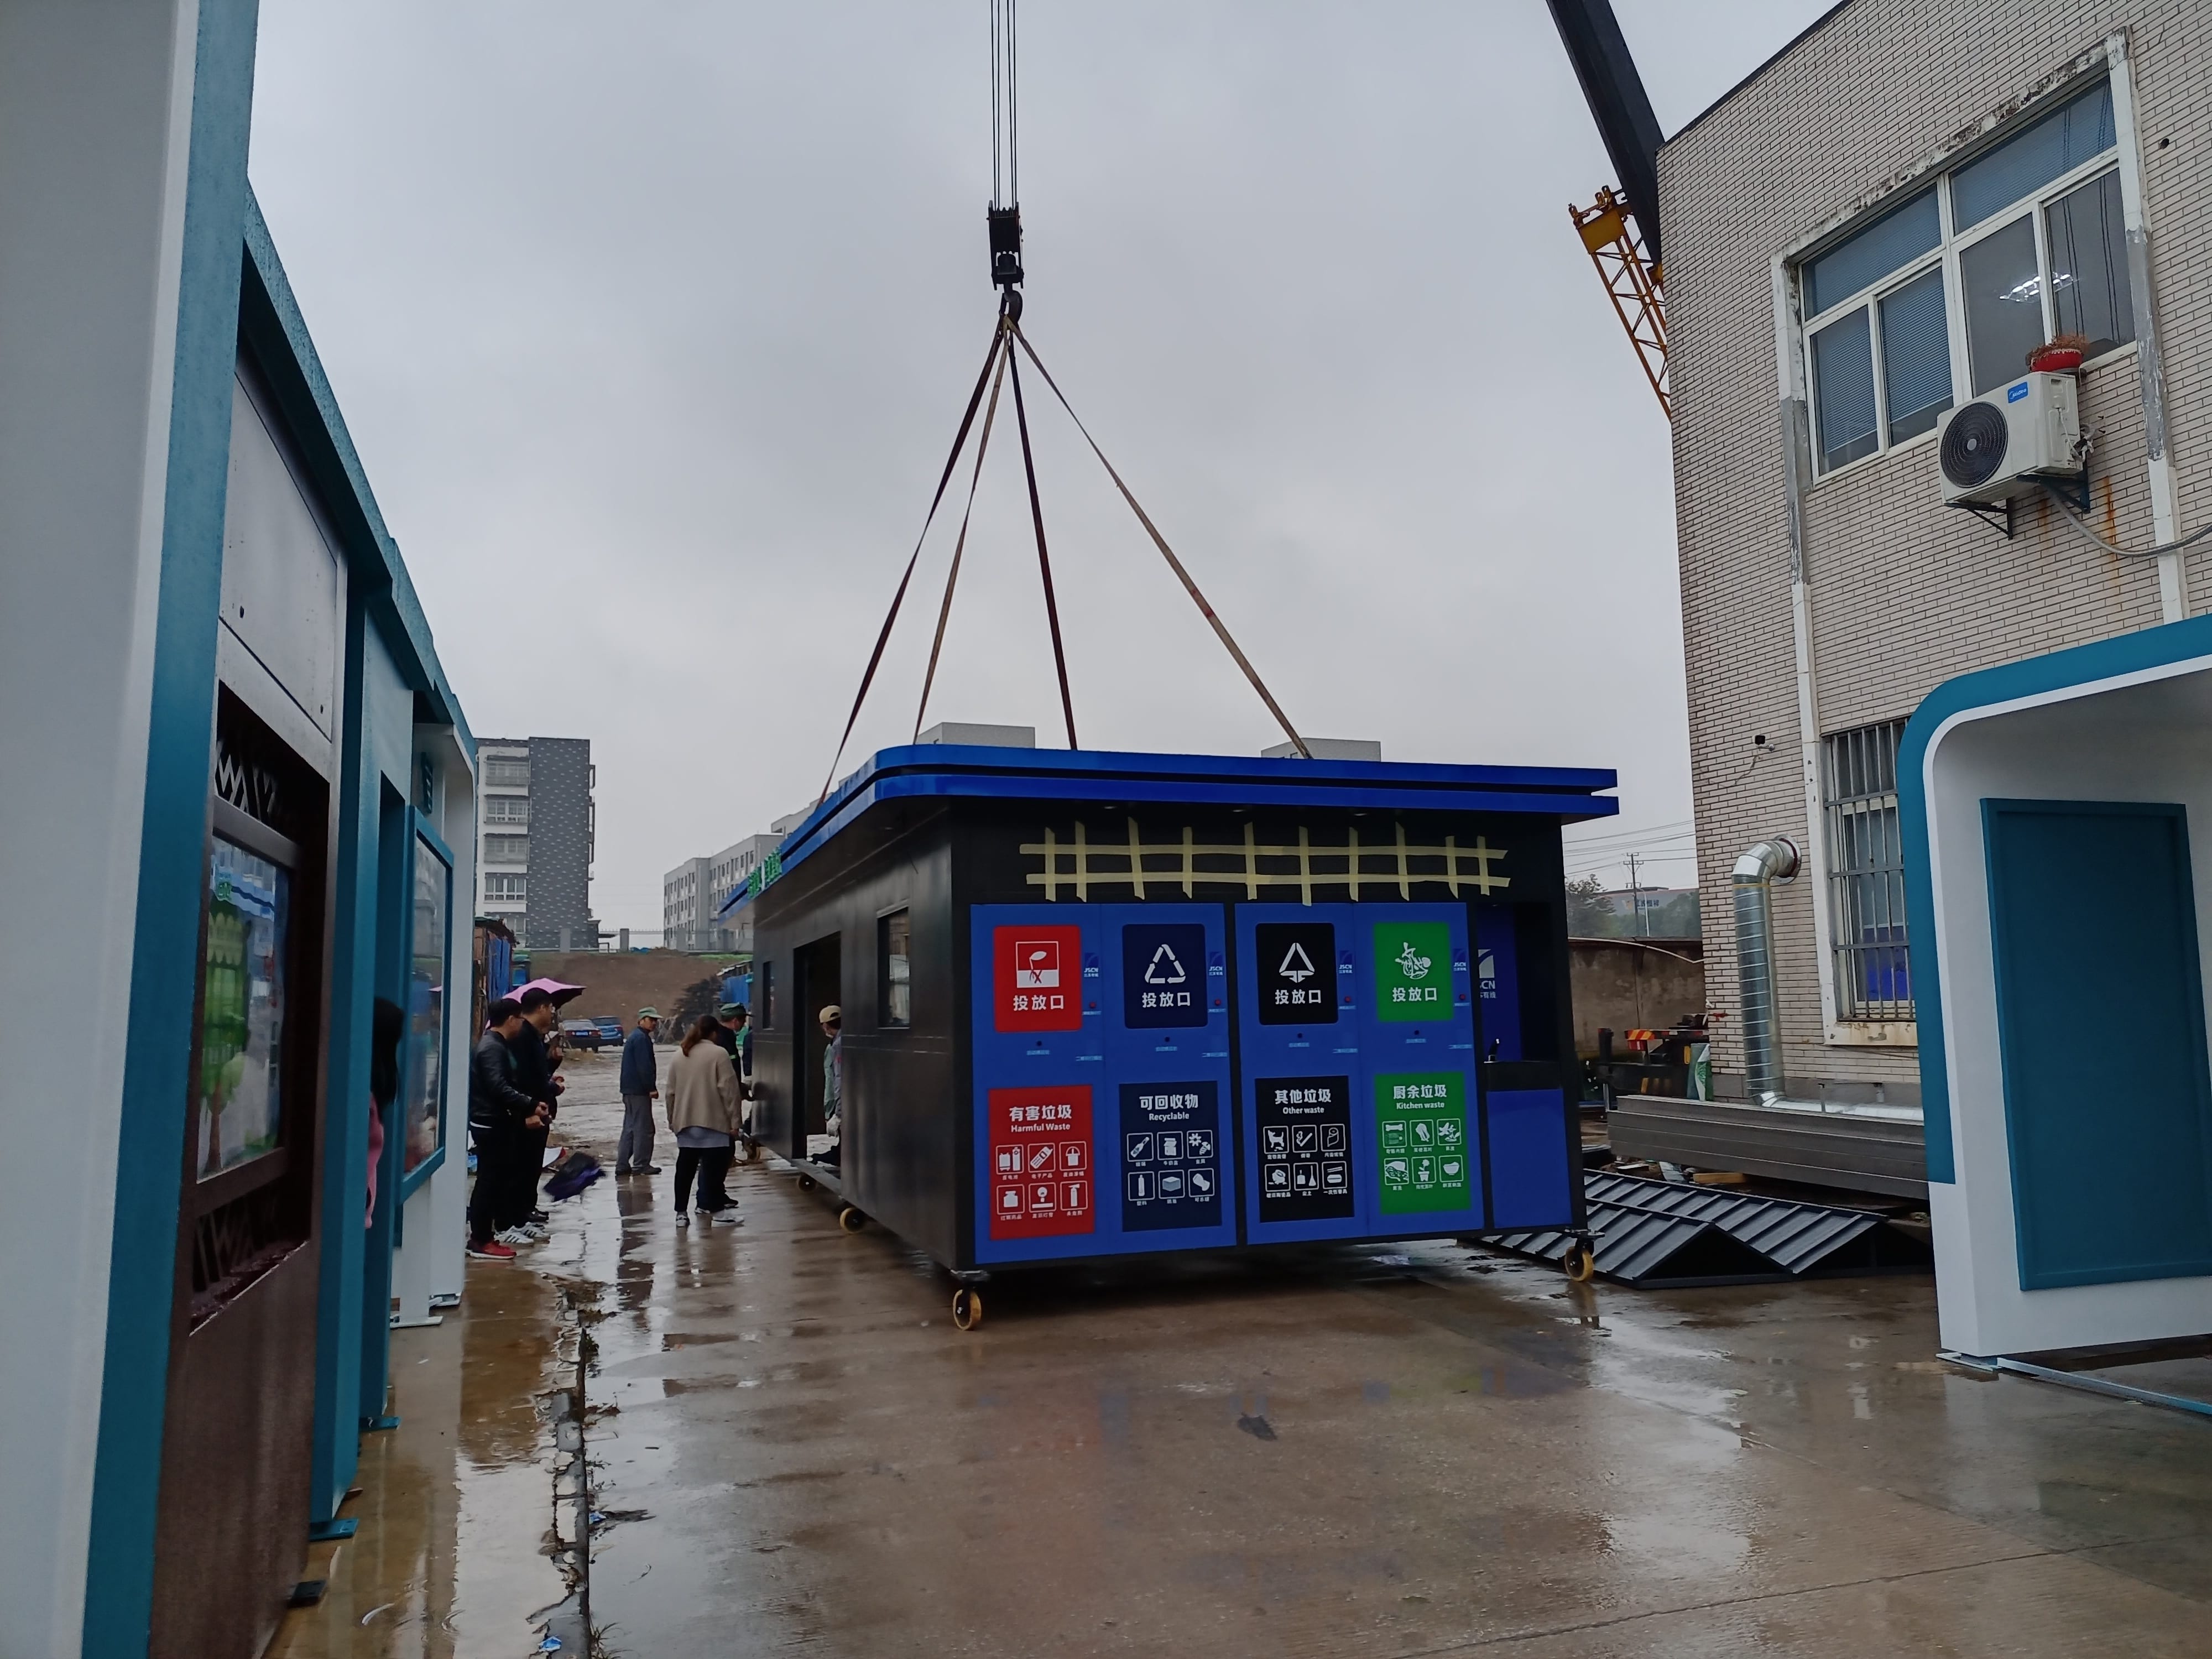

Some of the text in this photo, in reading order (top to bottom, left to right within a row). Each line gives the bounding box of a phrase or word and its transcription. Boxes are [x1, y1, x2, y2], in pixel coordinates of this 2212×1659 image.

[1142, 992, 1191, 1008] 投放口
[1275, 989, 1322, 1005] 投放口
[1392, 987, 1437, 1002] 投放口
[1013, 995, 1064, 1011] 投放口
[1275, 1089, 1331, 1105] 其他垃圾
[1394, 1084, 1447, 1099] 厨余垃圾
[1139, 1094, 1198, 1110] 可回收物
[1396, 1101, 1444, 1110] Kitchen waste
[1009, 1104, 1072, 1121] 有害垃圾
[1149, 1112, 1190, 1122] Recyclable
[1011, 1123, 1071, 1133] Harmful Waste
